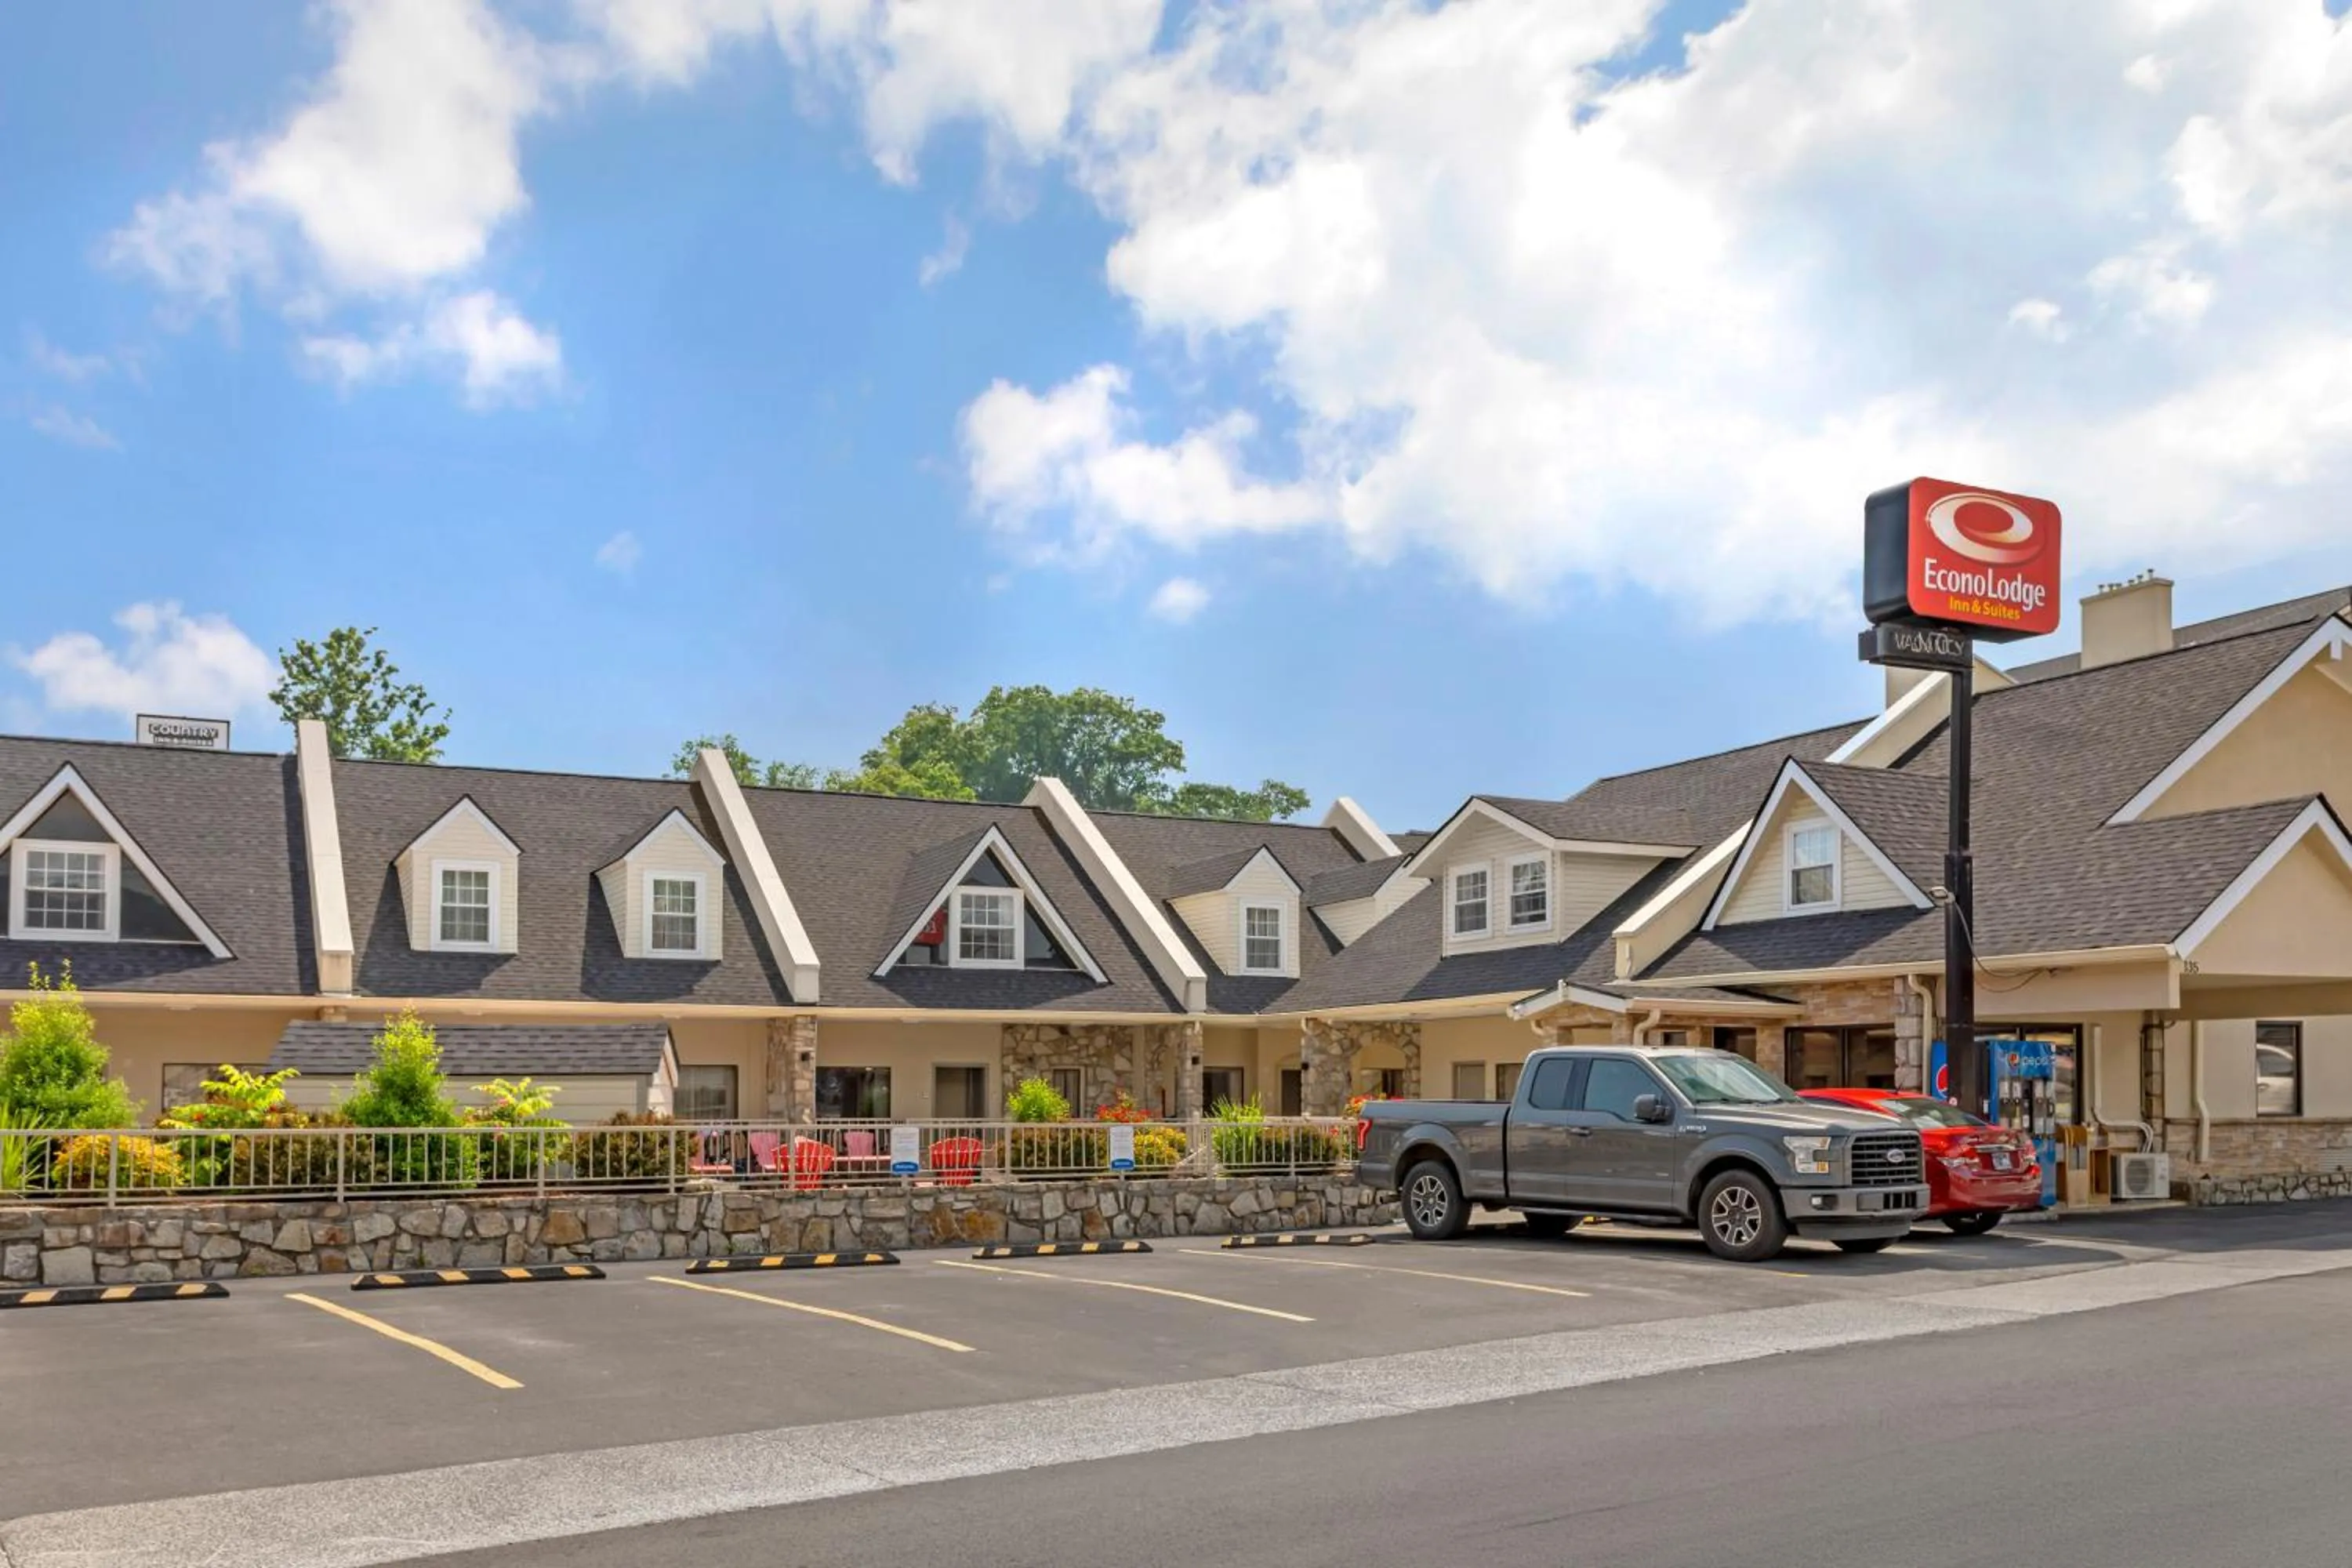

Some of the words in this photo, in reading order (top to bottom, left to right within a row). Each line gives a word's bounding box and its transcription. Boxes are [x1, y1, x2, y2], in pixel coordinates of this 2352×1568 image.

[1925, 557, 2045, 612] EconoLodge
[1949, 596, 1969, 612] Inn
[1972, 599, 1981, 615] &
[1983, 602, 2020, 620] Suites
